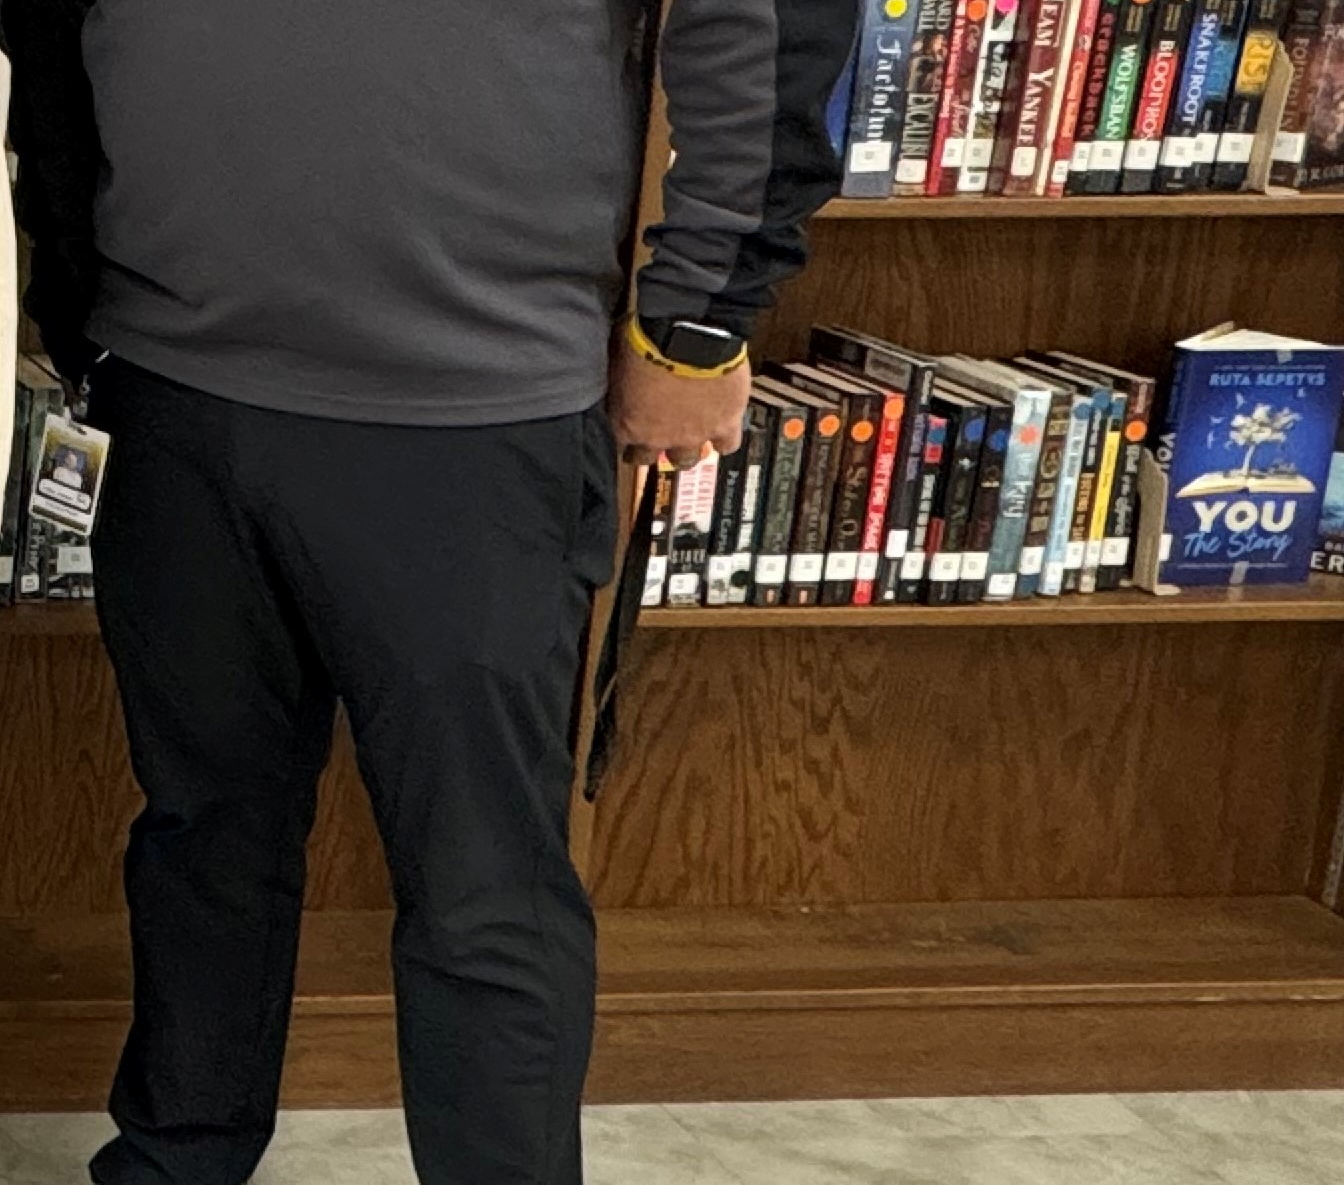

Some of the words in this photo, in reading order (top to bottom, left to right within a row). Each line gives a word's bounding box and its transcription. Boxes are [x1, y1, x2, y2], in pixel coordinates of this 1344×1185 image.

[1105, 44, 1136, 139] WOLFSBAN
[1139, 40, 1175, 140] BLOODROS
[1182, 13, 1217, 124] SNAKEROOT
[1017, 69, 1054, 144] YANKEE
[1209, 372, 1250, 386] RUTA
[1255, 372, 1325, 386] SEPETYS
[1157, 432, 1176, 471] YO
[677, 469, 699, 523] RICHTON
[1192, 500, 1297, 533] YOU
[1184, 533, 1222, 558] The
[1227, 533, 1293, 561] Story
